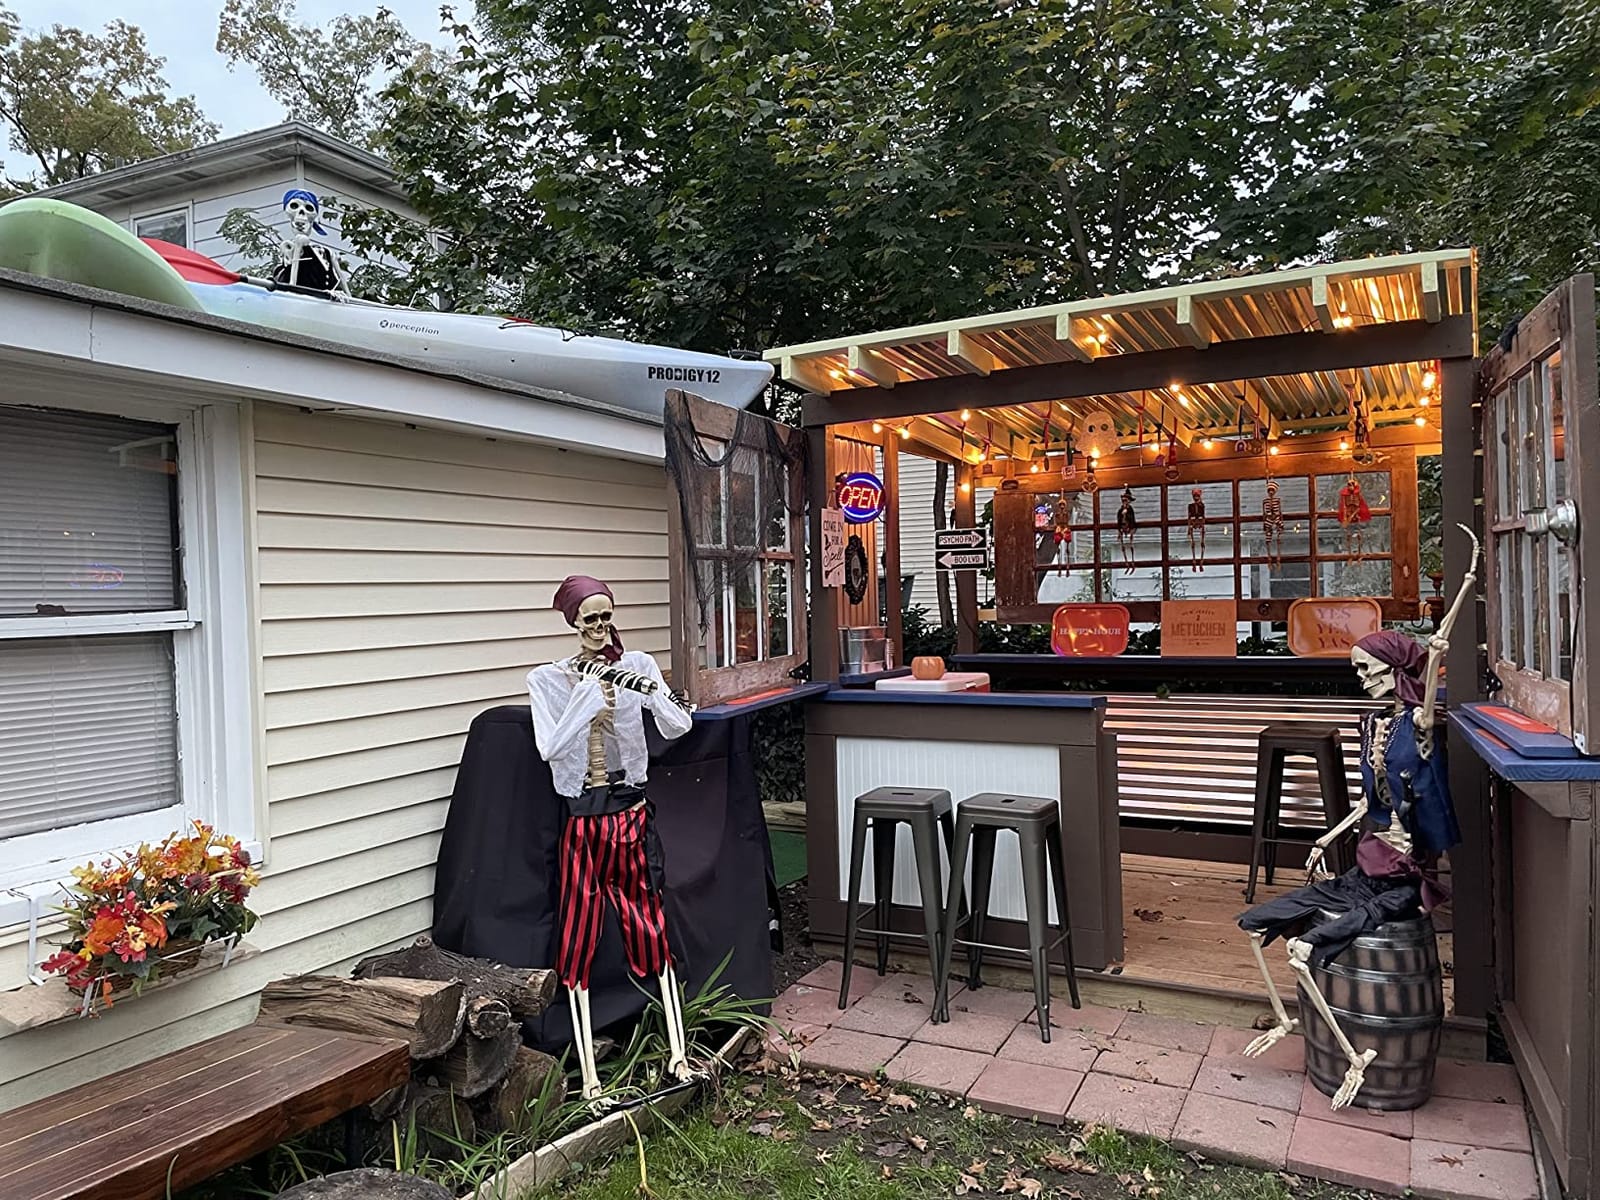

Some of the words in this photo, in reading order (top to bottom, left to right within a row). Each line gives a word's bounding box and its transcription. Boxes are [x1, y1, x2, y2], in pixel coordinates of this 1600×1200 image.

[389, 322, 440, 335] perception
[648, 366, 705, 383] PRODIGY
[706, 370, 721, 384] 12
[839, 486, 882, 509] OPEN
[824, 546, 844, 568] Spell
[1317, 607, 1352, 619] YES
[1171, 622, 1226, 637] METUCHEN
[1317, 637, 1351, 649] YAS
